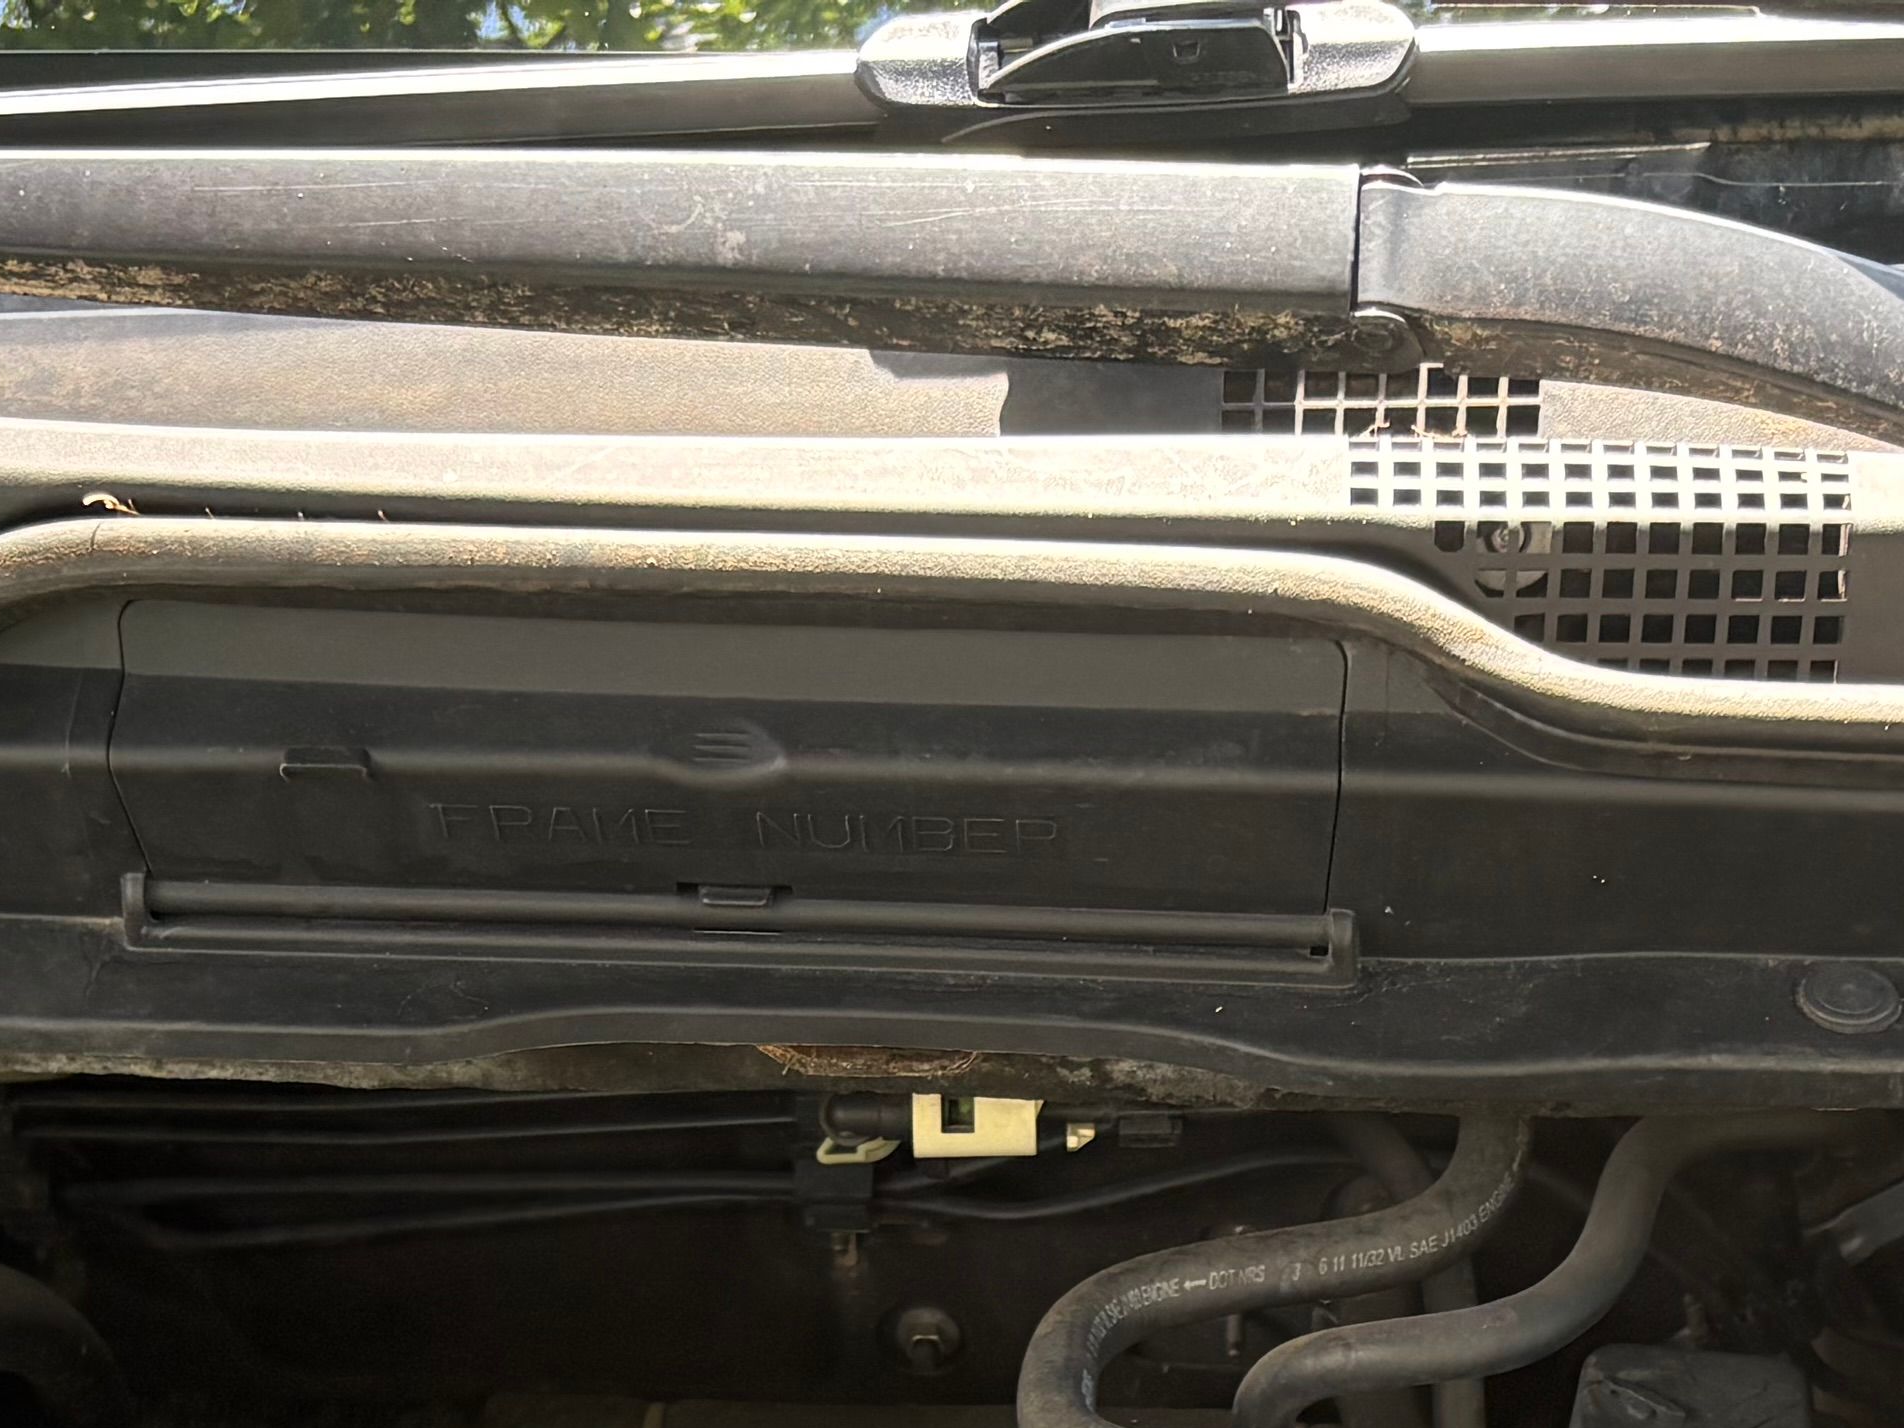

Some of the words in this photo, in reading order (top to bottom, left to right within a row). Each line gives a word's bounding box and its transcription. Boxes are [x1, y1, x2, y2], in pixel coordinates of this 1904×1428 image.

[428, 803, 693, 846] FRAME
[754, 810, 1058, 853] NUMBER
[1408, 1234, 1440, 1260] SAE
